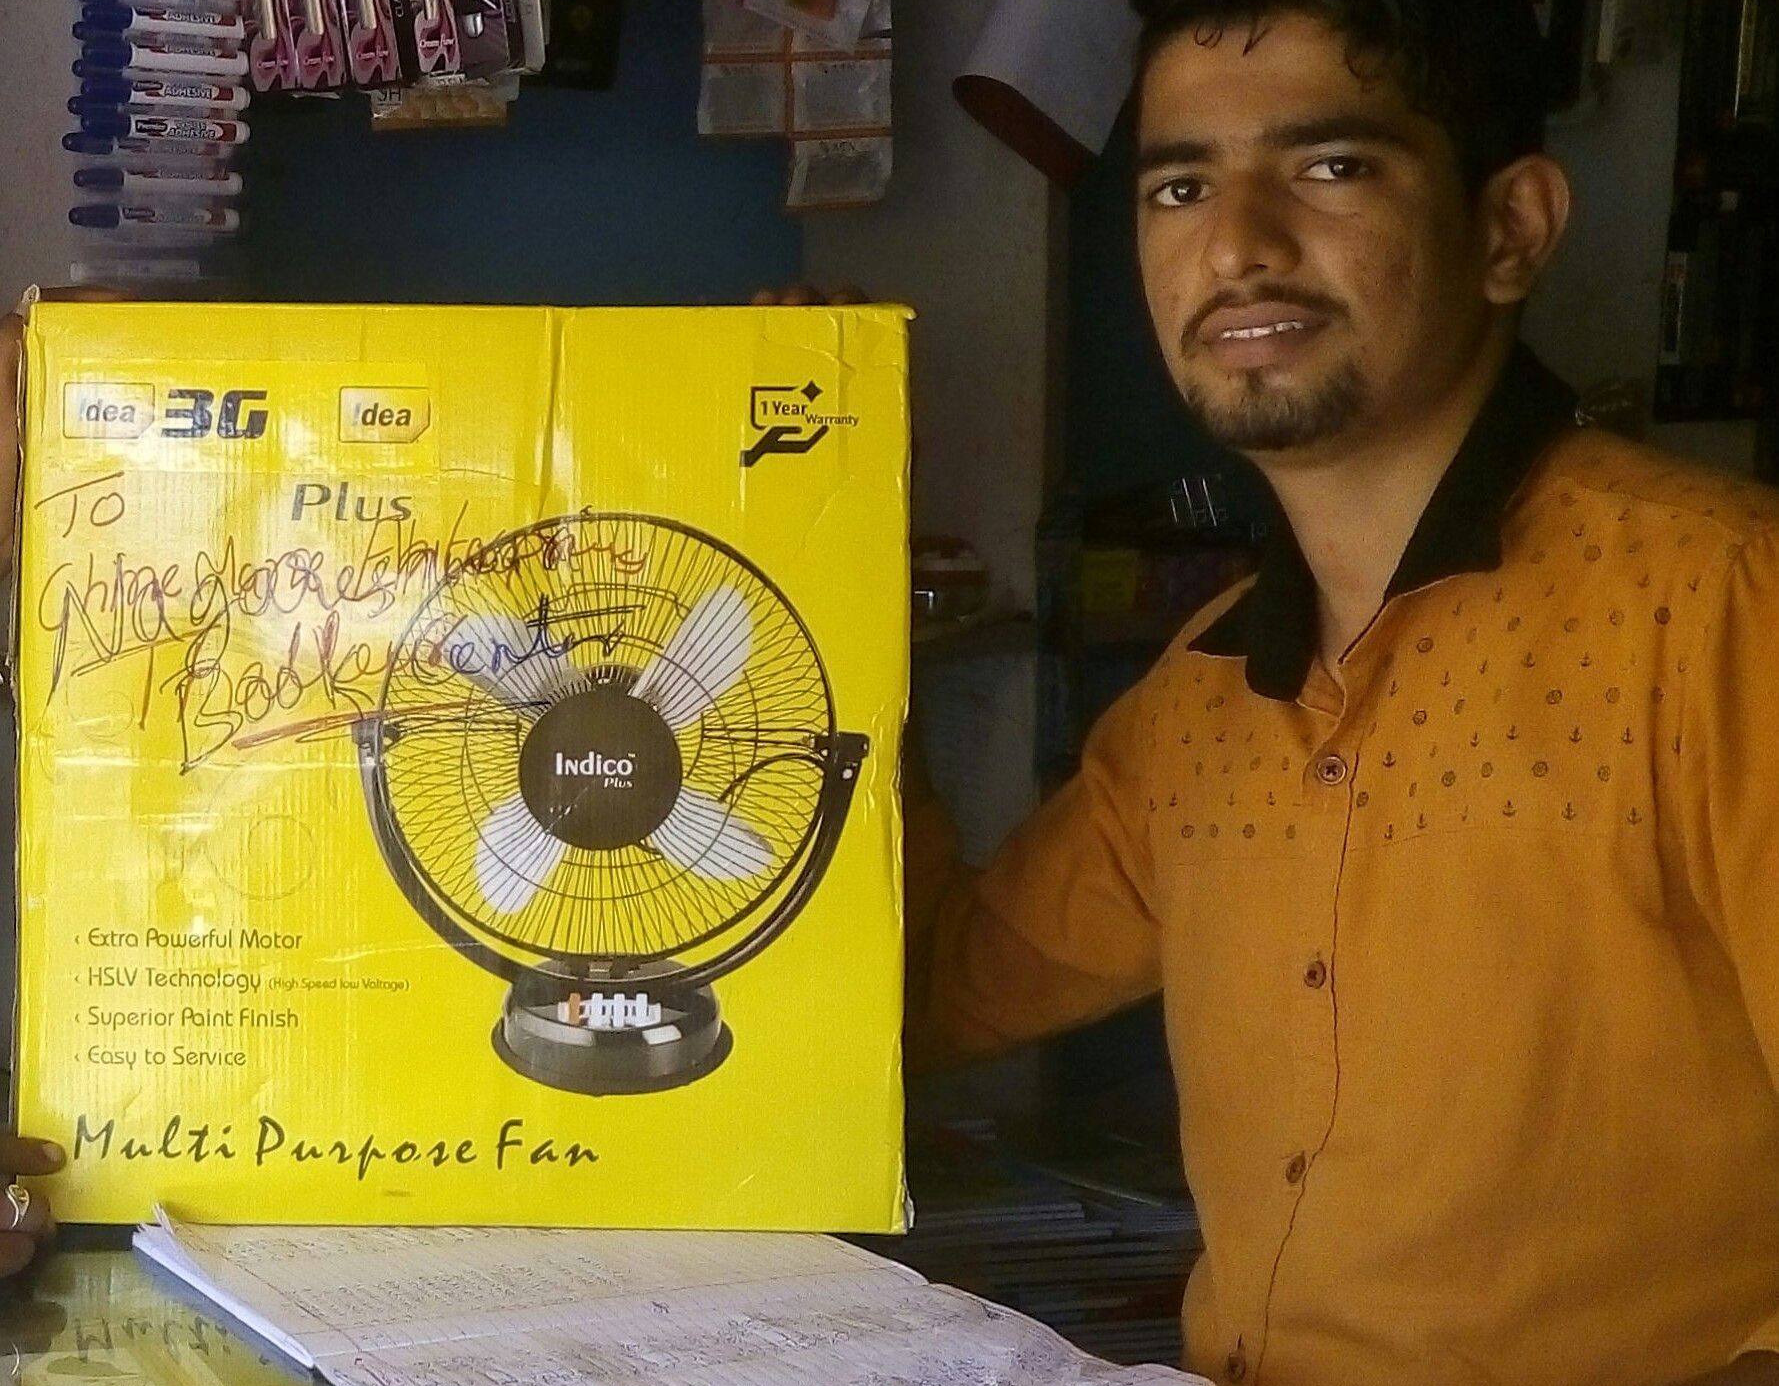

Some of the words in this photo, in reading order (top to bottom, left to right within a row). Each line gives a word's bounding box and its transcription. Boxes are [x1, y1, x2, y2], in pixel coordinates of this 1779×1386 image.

[163, 85, 214, 100] ADHESIVE
[161, 388, 270, 441] 3G
[760, 400, 769, 416] 1
[772, 400, 808, 416] Year
[805, 413, 860, 428] Warranty
[291, 480, 413, 523] Plus
[603, 776, 633, 788] Plus
[88, 927, 139, 949] Extra
[145, 927, 232, 950] Powerful
[239, 928, 303, 950] Motor
[88, 966, 138, 987] HSLV
[145, 966, 261, 993] Technology
[361, 978, 410, 992] Voltage)
[87, 1005, 174, 1031] Superior
[181, 1005, 234, 1028] Paint
[239, 1007, 299, 1029] Finish
[87, 1045, 137, 1071] Easy
[144, 1046, 166, 1066] to
[172, 1045, 247, 1067] Service
[73, 1113, 237, 1162] Multi
[255, 1114, 478, 1181] Purpose
[495, 1118, 601, 1171] Fan
